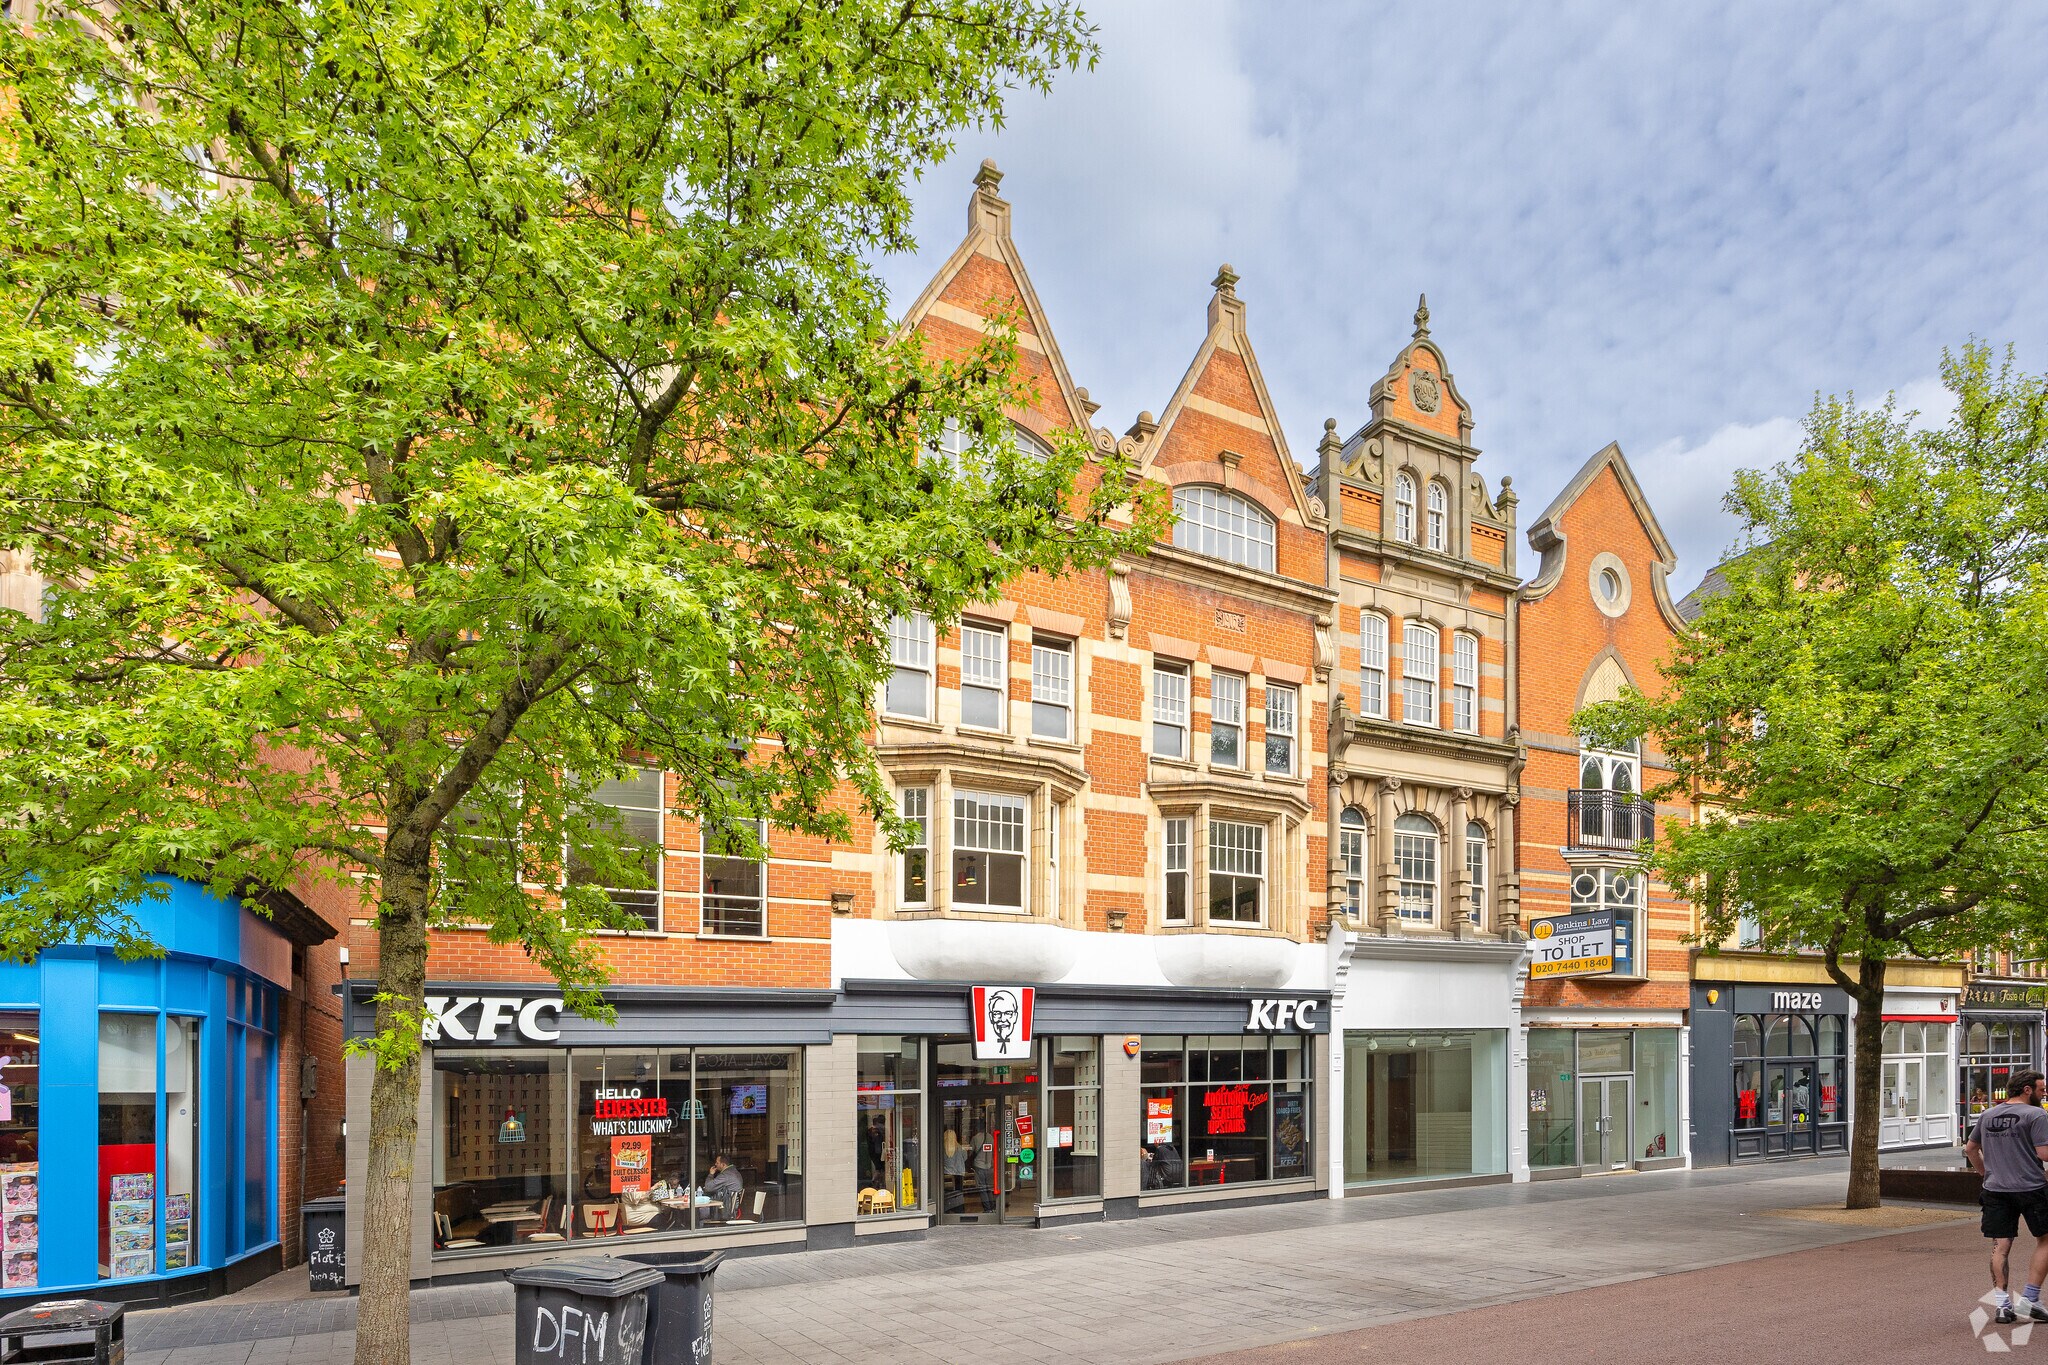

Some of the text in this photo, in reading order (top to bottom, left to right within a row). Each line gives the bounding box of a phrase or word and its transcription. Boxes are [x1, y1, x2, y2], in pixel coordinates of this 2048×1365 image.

[1535, 925, 1552, 936] JL
[1556, 921, 1588, 933] Jenkins
[1558, 935, 1585, 946] SHOP
[1541, 942, 1603, 961] TO LET
[1535, 958, 1608, 973] 020 7440 1840
[1774, 992, 1822, 1009] maze
[2000, 989, 2018, 1003] Taste
[2019, 991, 2025, 1001] of
[422, 996, 565, 1041] KFC
[1246, 999, 1318, 1030] KFC
[595, 1088, 641, 1099] HELLO
[595, 1098, 668, 1118] LEICESTER
[1210, 1105, 1245, 1120] SEATING
[593, 1119, 672, 1135] WHAT'S CLUCKIN'?
[1207, 1118, 1246, 1135] UPSTAIRS
[620, 1141, 642, 1150] £2.99
[627, 1167, 650, 1175] CLASSIC
[620, 1175, 641, 1183] SAVERS
[310, 1250, 335, 1265] Flat
[532, 1305, 609, 1364] DFM
